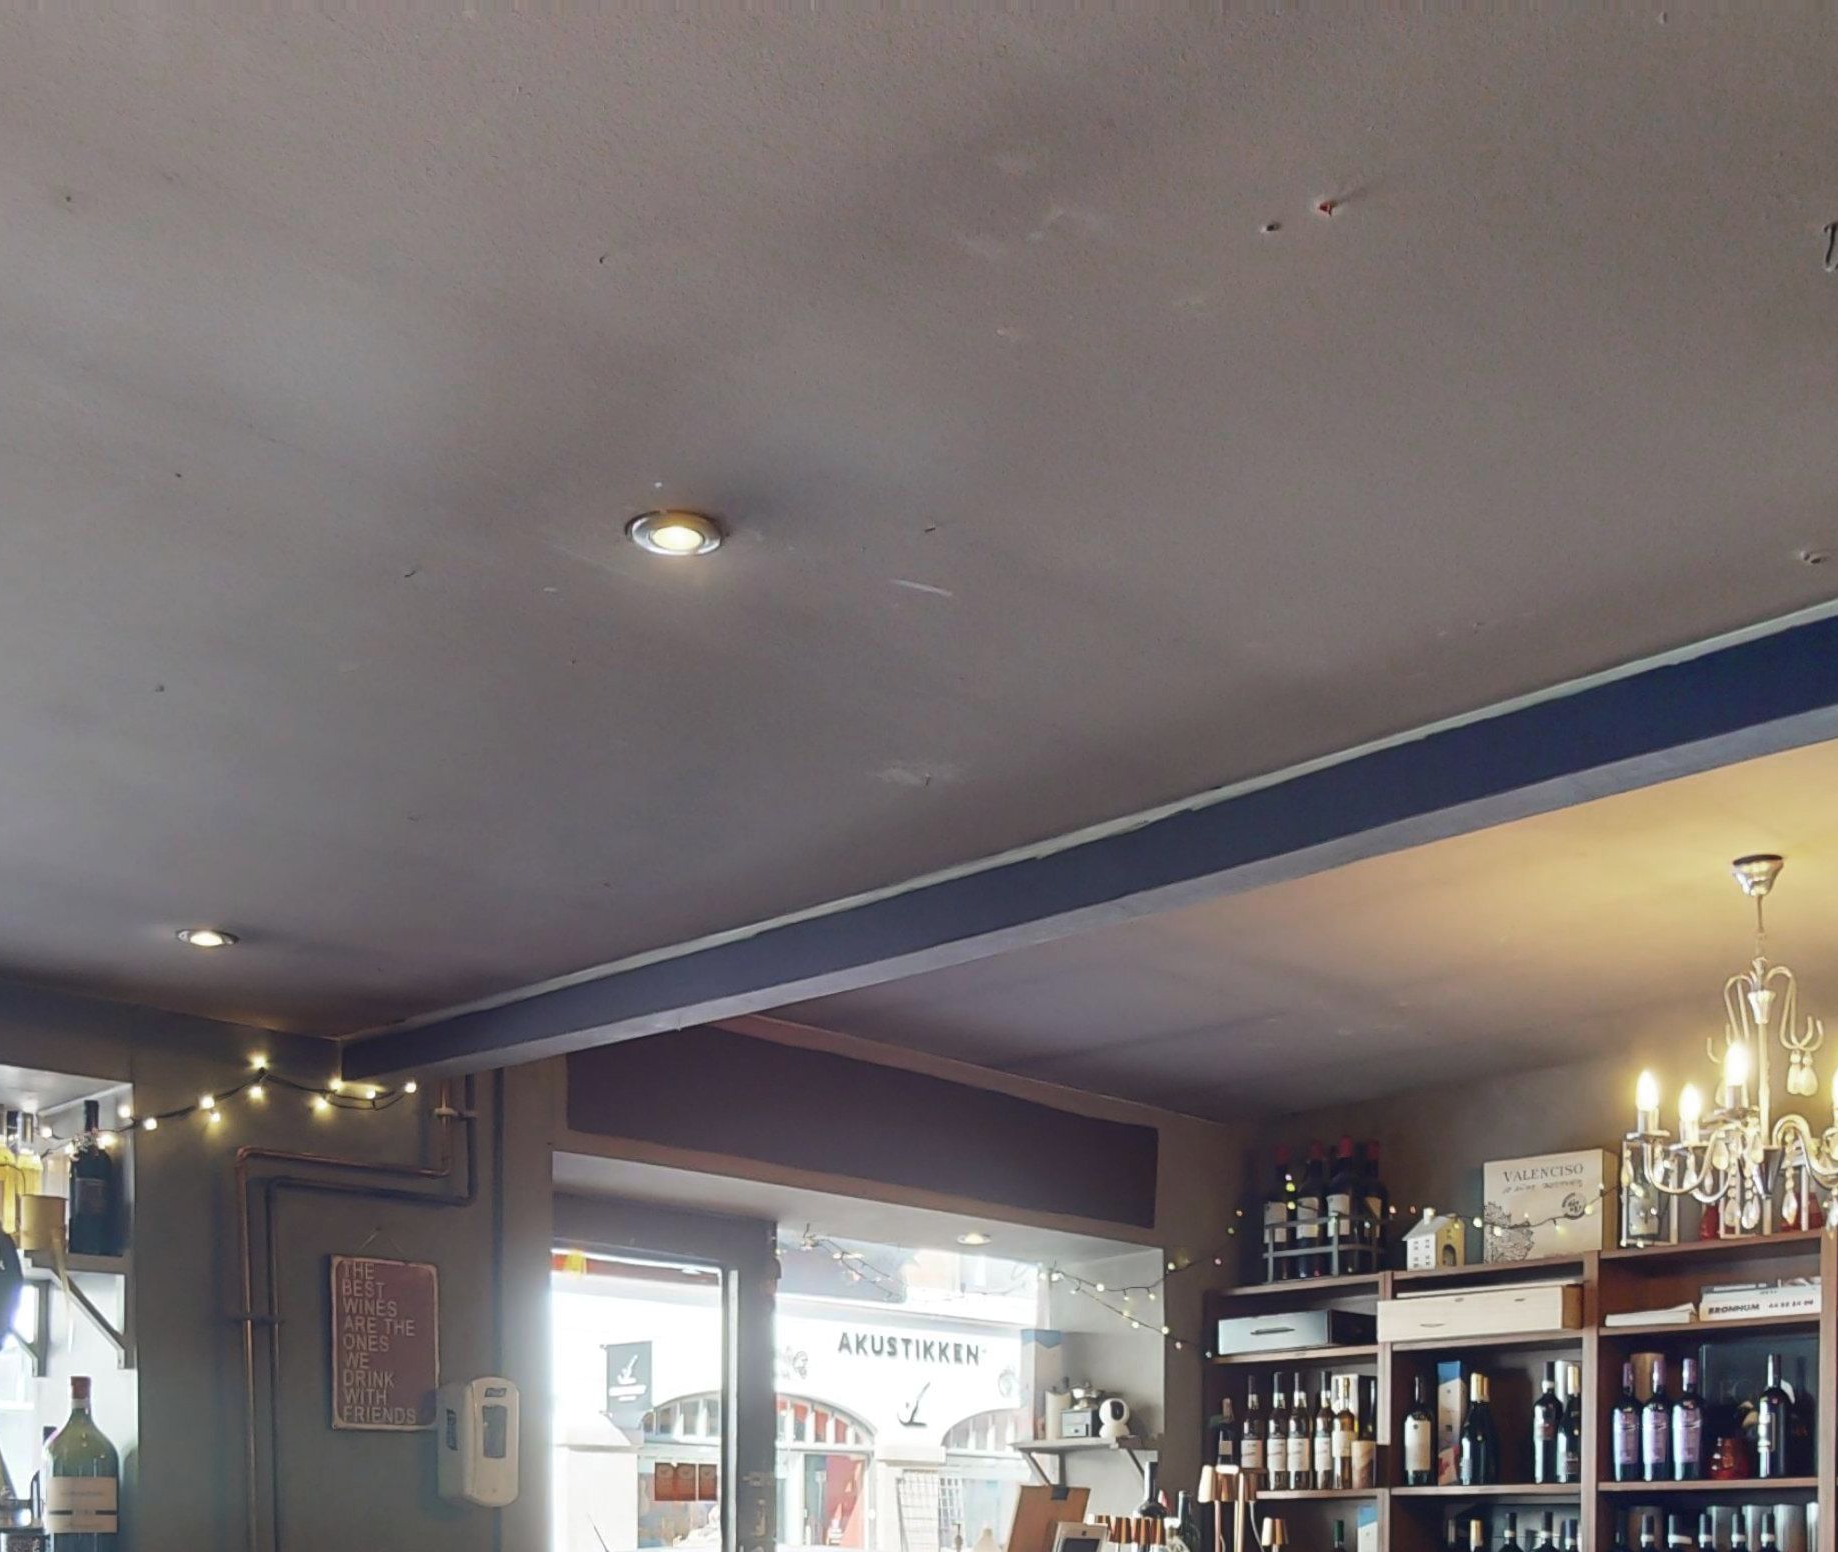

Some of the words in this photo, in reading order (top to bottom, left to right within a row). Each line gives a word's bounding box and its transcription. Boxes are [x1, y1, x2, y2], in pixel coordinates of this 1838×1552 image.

[1503, 1163, 1584, 1182] VALENCISO
[342, 1261, 375, 1280] THE
[343, 1280, 385, 1298] BEST
[343, 1298, 398, 1317] WINES
[343, 1316, 377, 1334] ARE
[385, 1319, 415, 1337] THE
[342, 1335, 390, 1353] ONES
[838, 1331, 979, 1366] AKUSTIKKEN
[345, 1352, 370, 1370] WE
[343, 1369, 395, 1389] DRINK
[343, 1388, 387, 1406] WITH
[343, 1407, 417, 1425] FRIENDS
